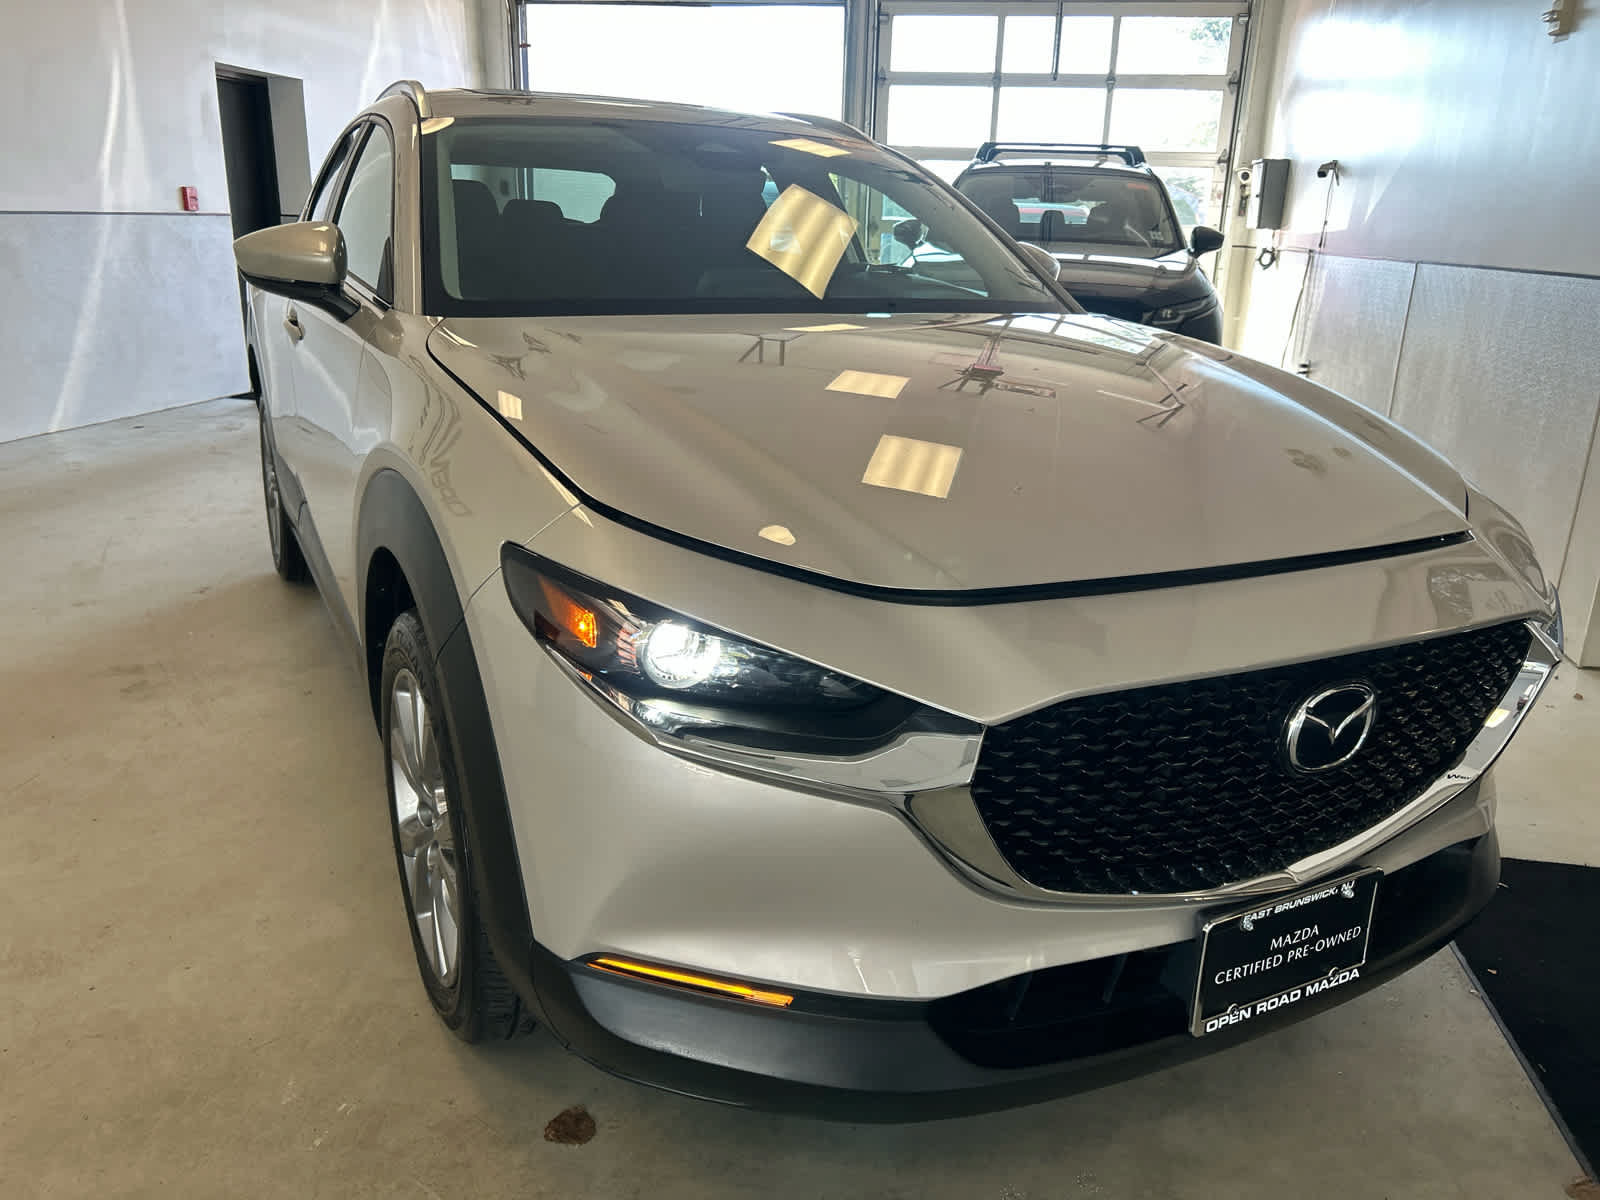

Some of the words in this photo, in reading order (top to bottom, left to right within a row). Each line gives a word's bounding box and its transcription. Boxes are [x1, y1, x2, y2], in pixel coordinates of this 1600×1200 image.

[1214, 954, 1283, 985] CERTIFIED
[1287, 926, 1361, 963] PRE-OWNED
[1270, 924, 1319, 951] MAZDA
[1206, 1006, 1252, 1033] OPEN
[1255, 989, 1301, 1015] ROAD
[1305, 968, 1360, 997] MAZDA
